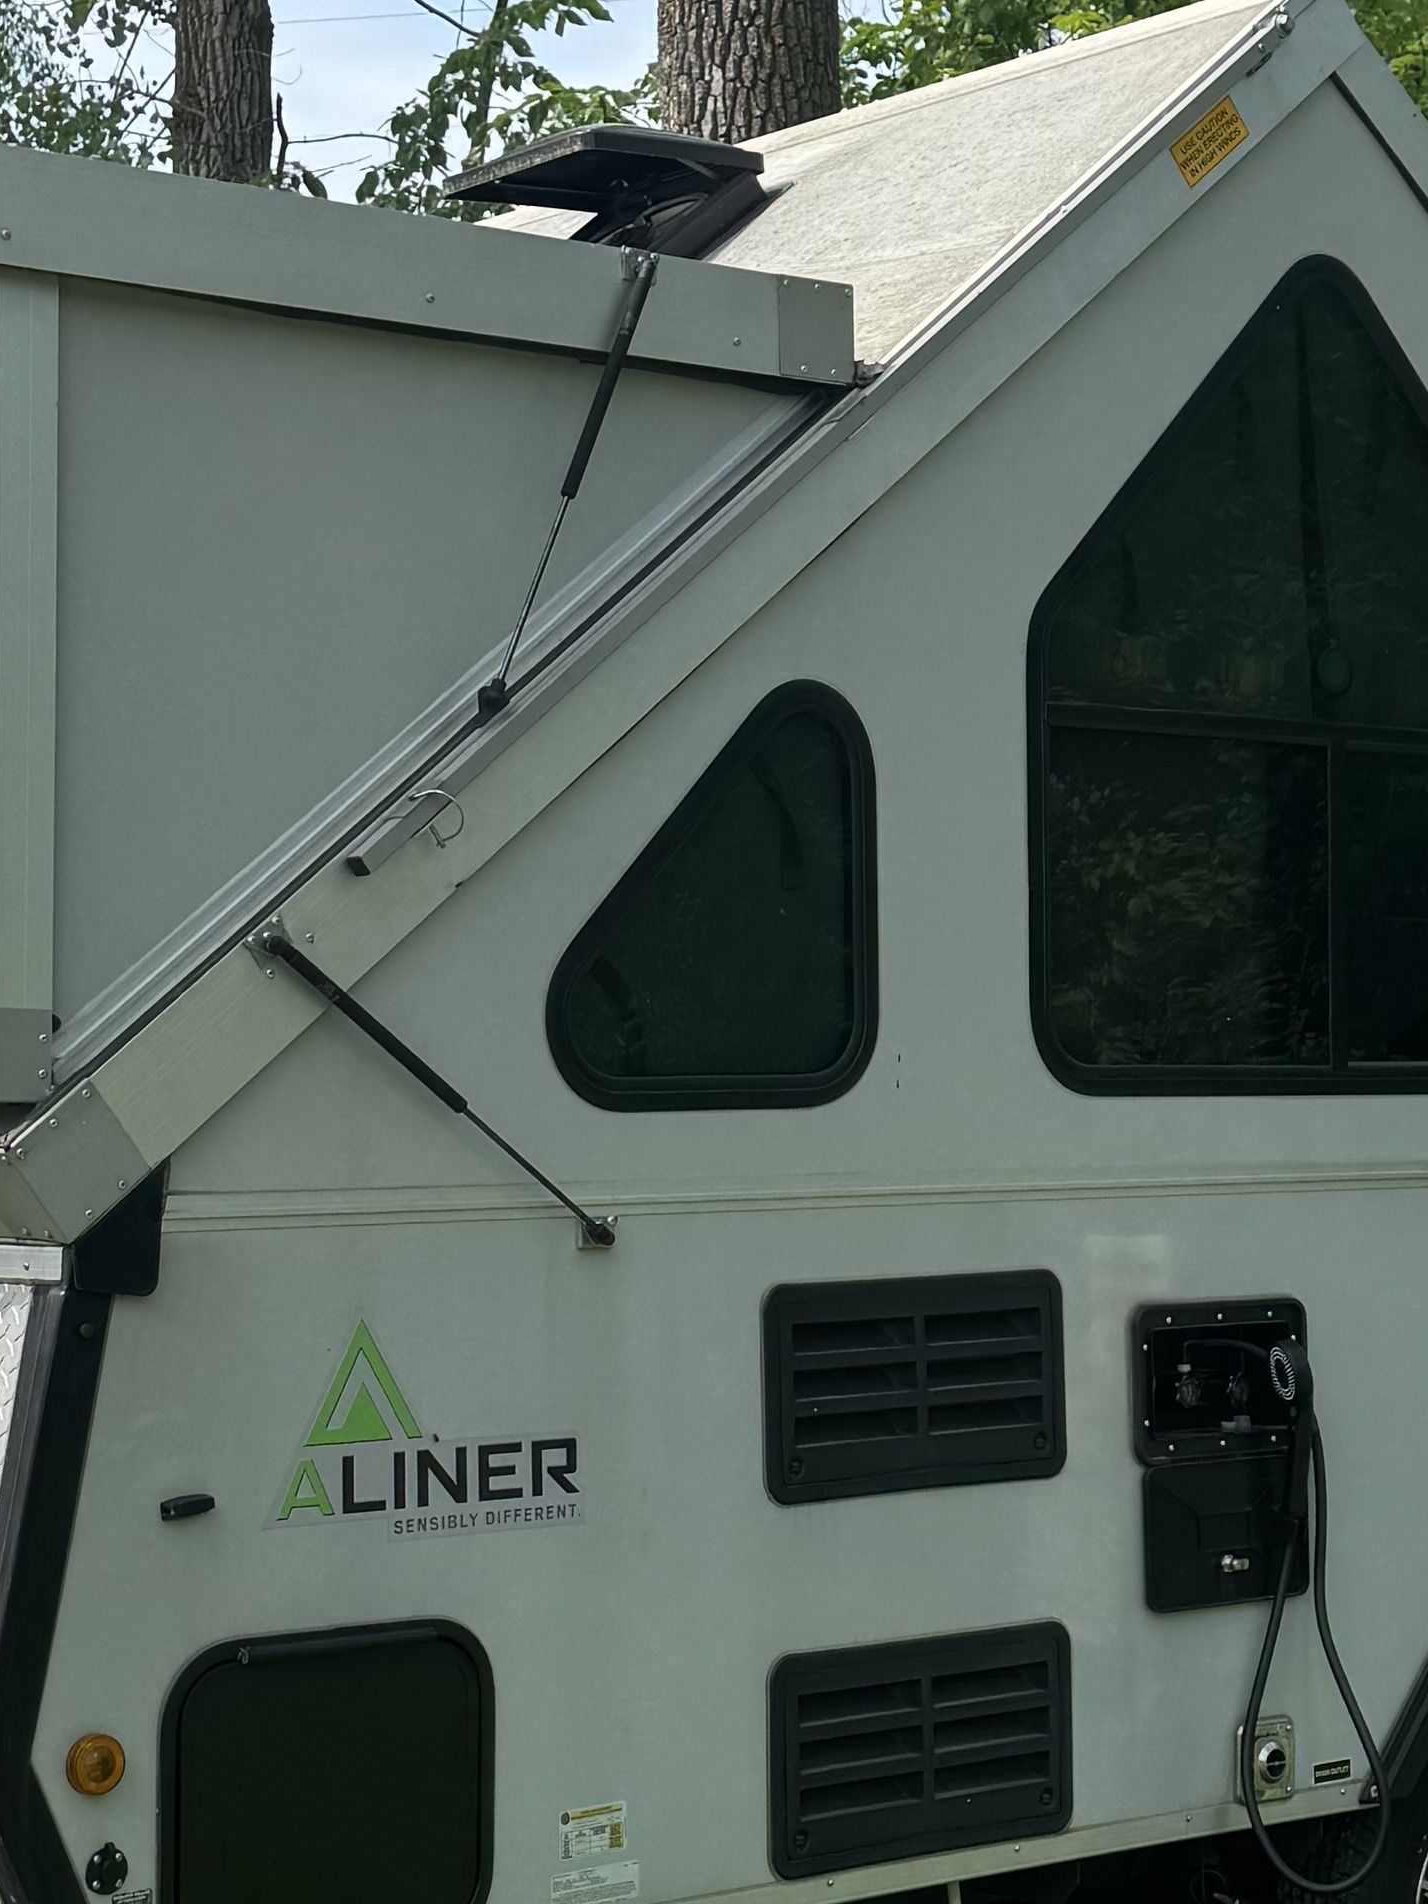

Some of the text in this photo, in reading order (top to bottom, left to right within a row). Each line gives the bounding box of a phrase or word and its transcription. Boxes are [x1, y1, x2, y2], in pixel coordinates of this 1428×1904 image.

[1195, 107, 1229, 141] CAUTION
[1203, 113, 1239, 151] ERECTING
[276, 1436, 581, 1521] ALINER
[393, 1502, 582, 1535] SENSIBLY DIFFERENT.
